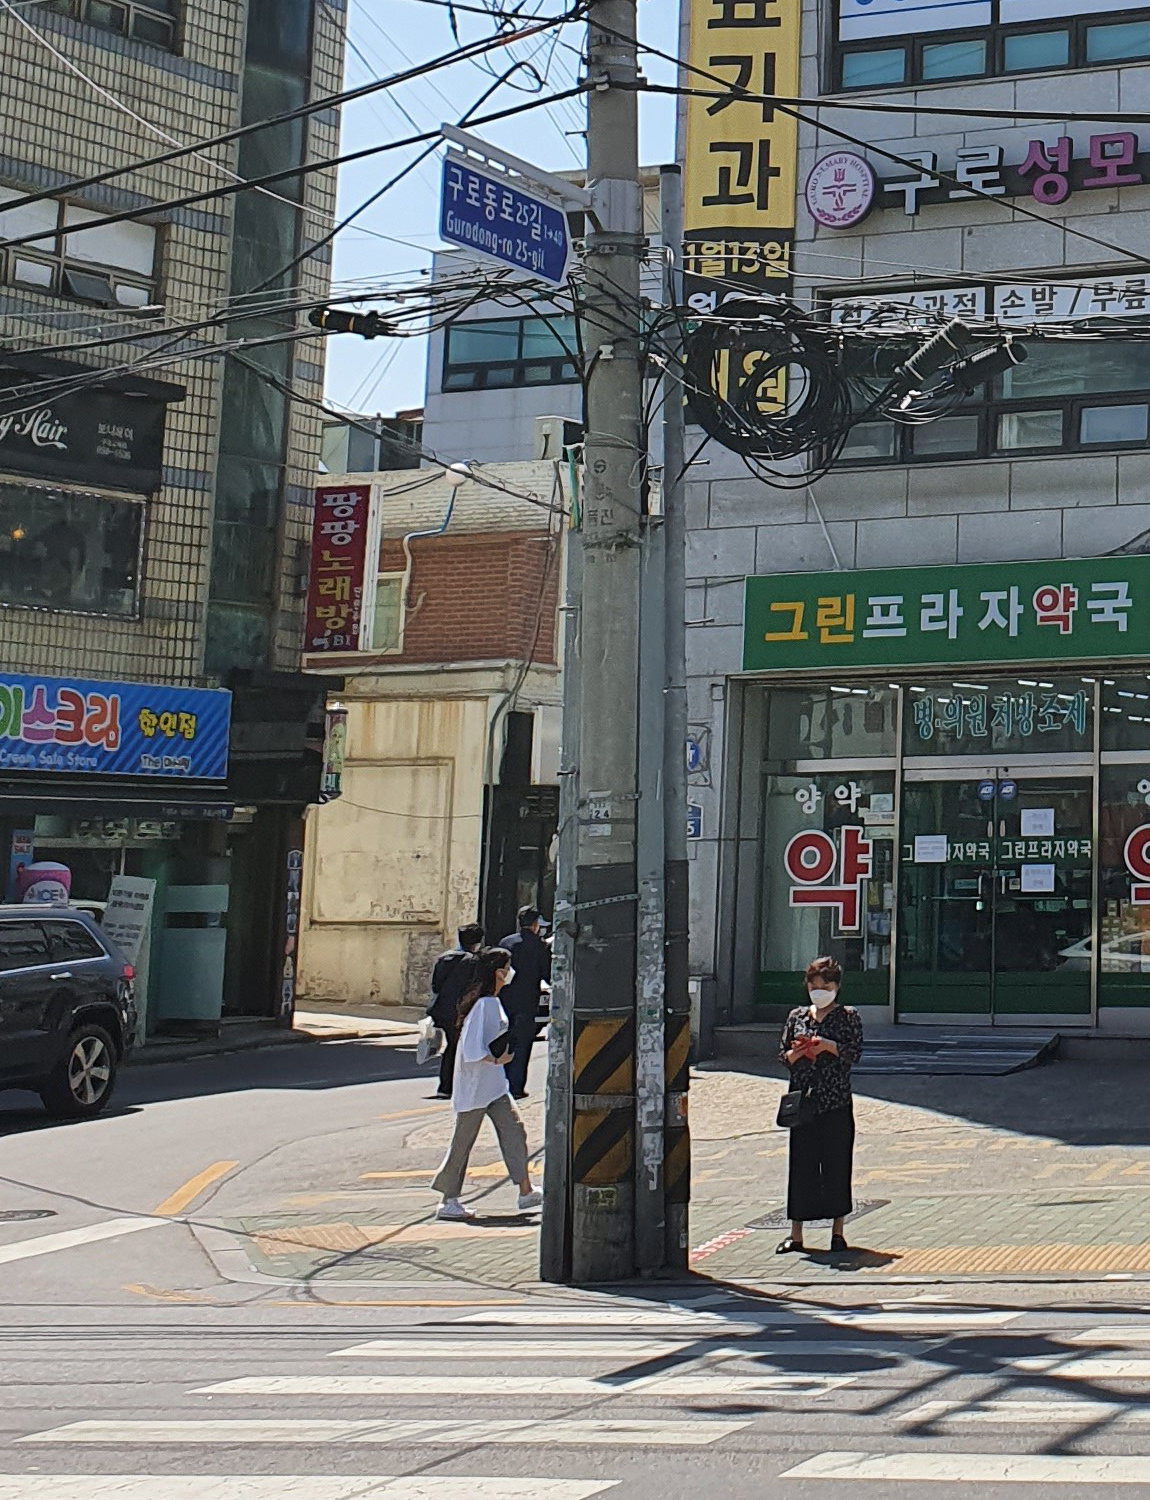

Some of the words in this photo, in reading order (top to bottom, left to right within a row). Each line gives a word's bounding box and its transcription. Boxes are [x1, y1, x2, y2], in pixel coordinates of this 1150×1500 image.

[448, 166, 542, 242] 구로동로25길
[446, 209, 512, 258] Gurodong-ro
[515, 239, 545, 271] 25-gil
[15, 409, 68, 450] Hair
[784, 825, 873, 931] 약
[1001, 840, 1092, 860] 그린프라자약국
